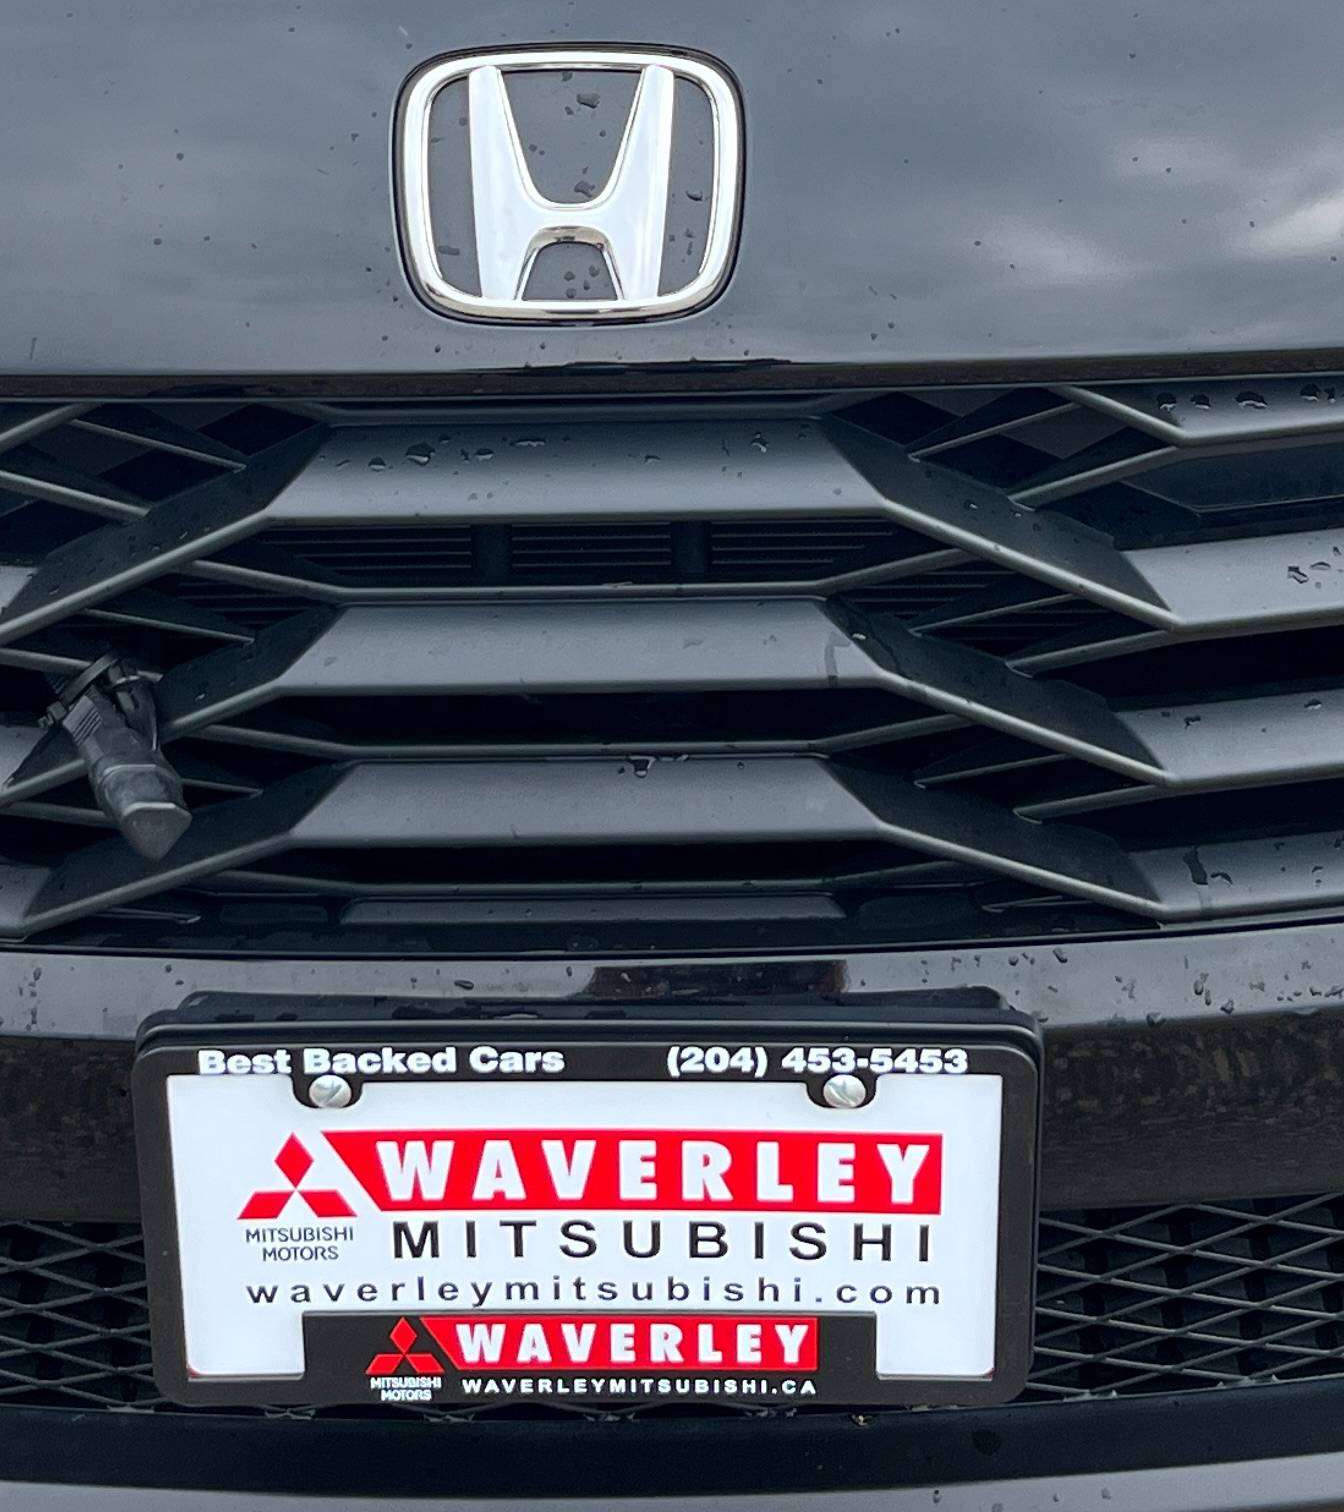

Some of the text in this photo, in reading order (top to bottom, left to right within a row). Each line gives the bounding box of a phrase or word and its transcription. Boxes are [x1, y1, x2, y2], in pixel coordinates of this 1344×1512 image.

[197, 1046, 565, 1075] Best Backed Cars
[667, 1046, 969, 1078] (204) 453-5453
[375, 1138, 931, 1205] WAVERLEY
[245, 1226, 354, 1243] MITSUBISHI
[393, 1220, 930, 1263] MITSUBISHI
[262, 1245, 340, 1262] MOTORS
[246, 1276, 942, 1308] waverleymitsubishi.com
[455, 1323, 810, 1364] WAVERLEY
[370, 1376, 442, 1390] MITSUBISHI
[381, 1389, 432, 1402] MOTORS
[462, 1378, 817, 1396] WAVERLEYMITSUBISHI.CA
